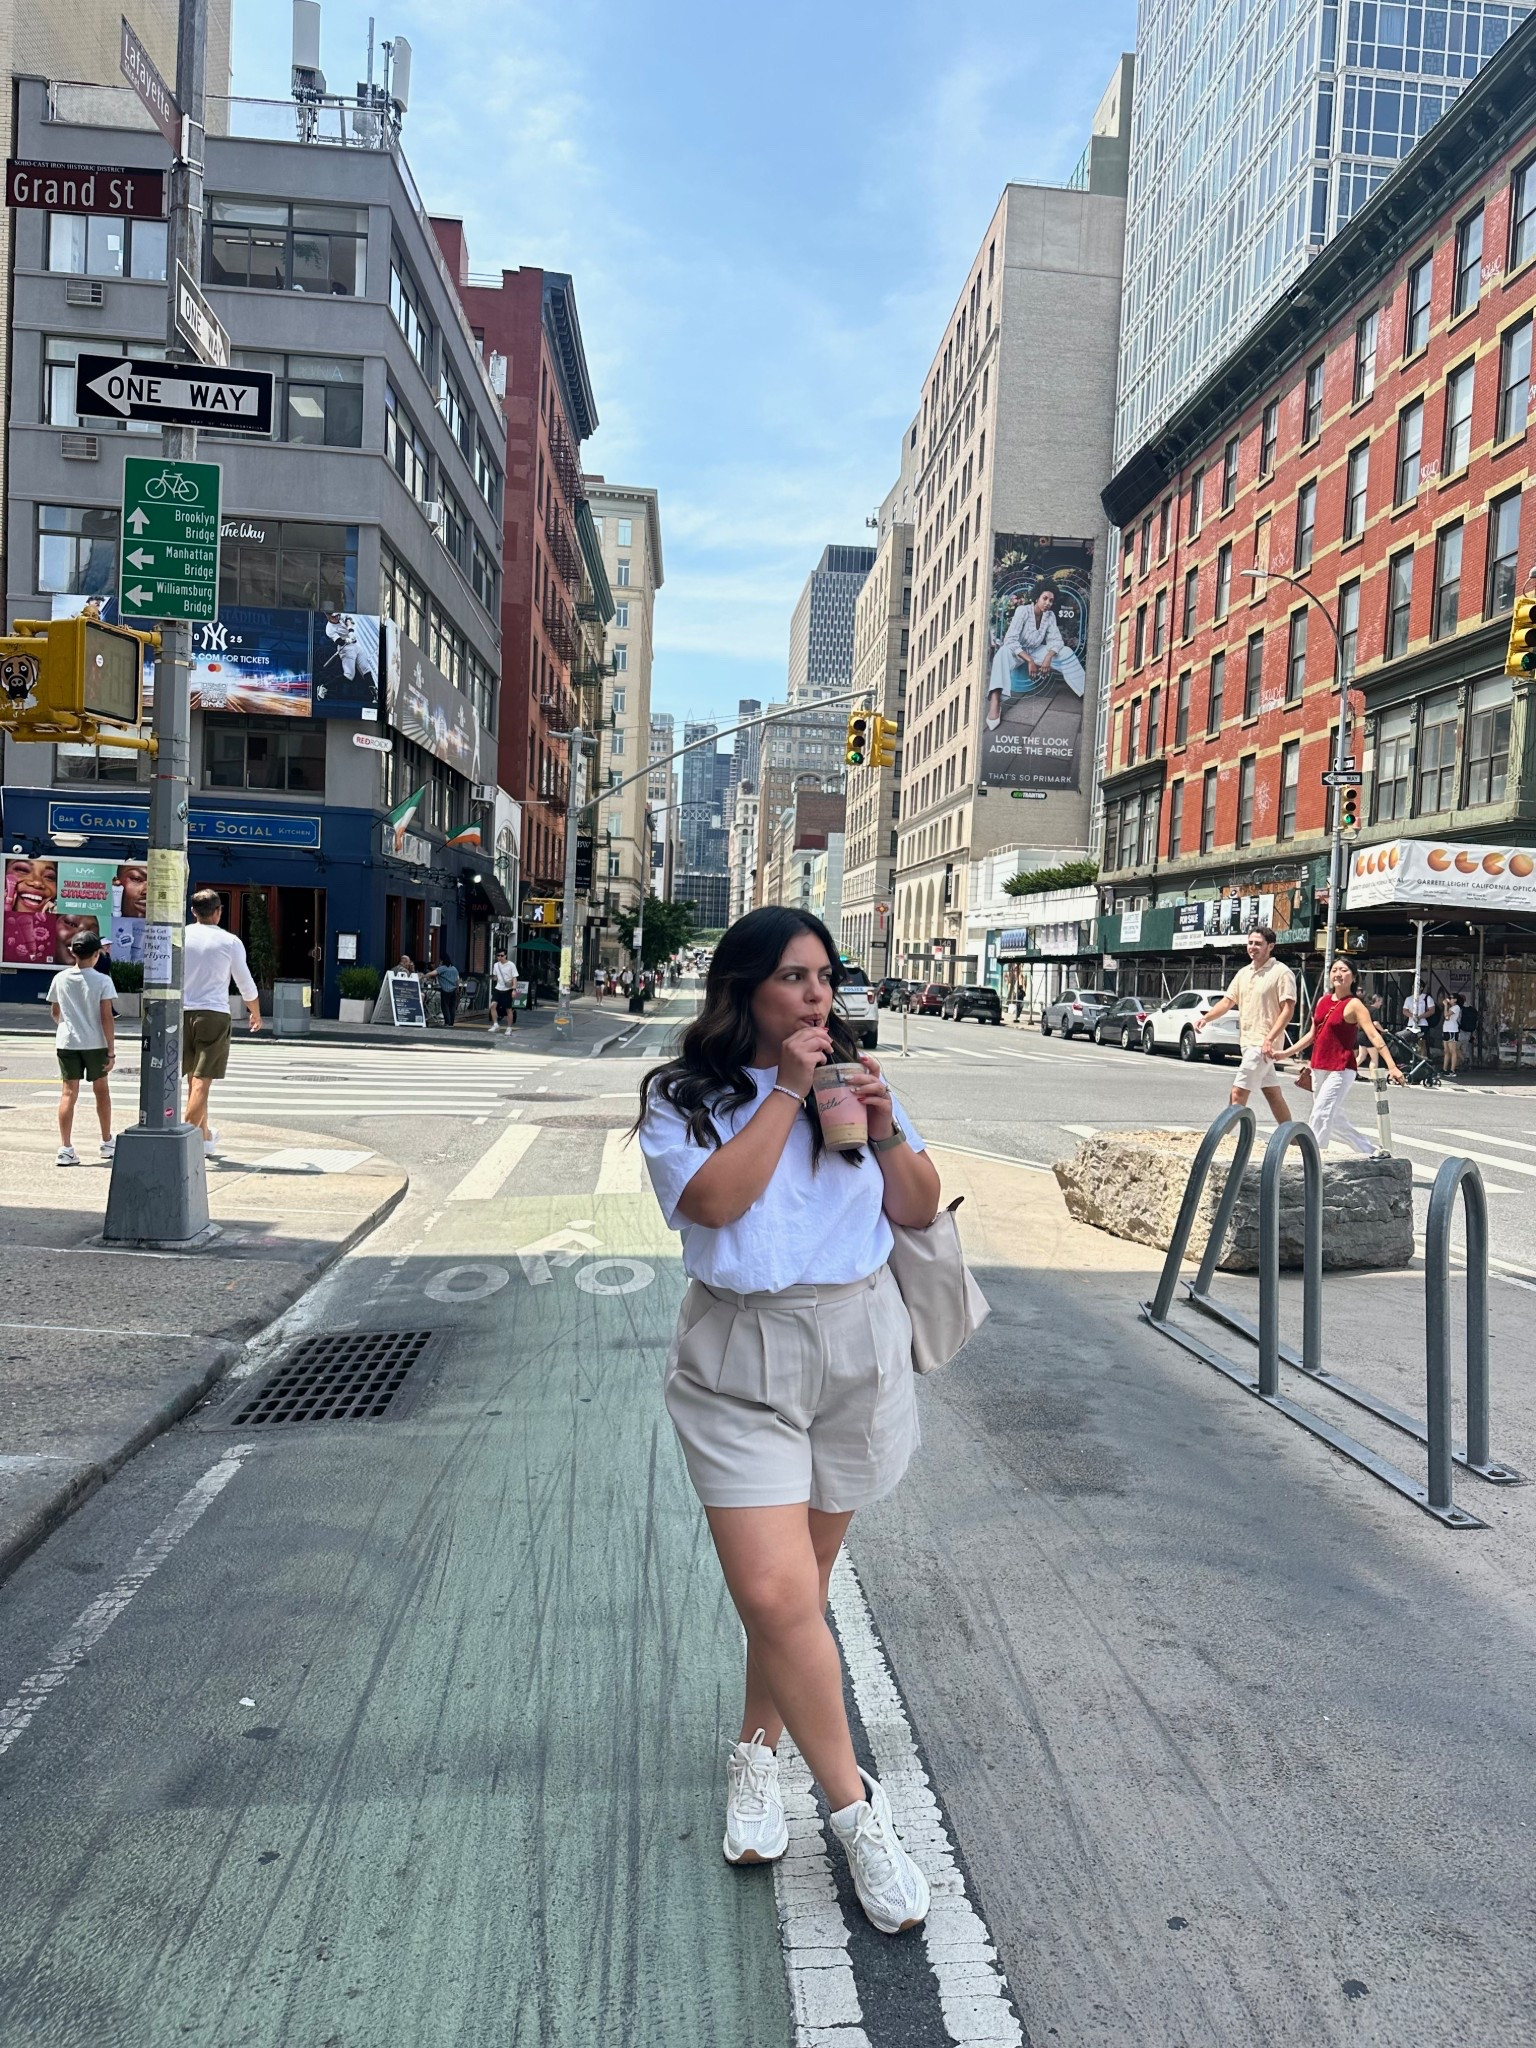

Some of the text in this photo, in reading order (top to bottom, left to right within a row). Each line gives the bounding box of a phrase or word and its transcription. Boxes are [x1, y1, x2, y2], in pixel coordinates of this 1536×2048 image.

[124, 34, 170, 123] Lafayette
[14, 160, 49, 168] SOHO-CAST
[66, 163, 97, 172] HISTORIC
[97, 165, 125, 173] DISTRICT
[13, 172, 135, 210] Grand St
[185, 296, 223, 363] ONE WAY
[107, 375, 248, 412] ONE WAY
[175, 509, 215, 526] Brooklyn
[185, 526, 215, 544] Bridge
[239, 522, 265, 544] Way
[166, 546, 214, 561] Manhattan
[184, 564, 214, 580] Bridge
[156, 581, 213, 601] Williamsburg
[183, 600, 213, 617] Bridge
[1058, 609, 1075, 619] $20
[222, 654, 239, 663] FOR
[240, 655, 270, 665] TICKETS
[995, 735, 1069, 747] LOVE THE LOOK
[989, 745, 1074, 757] ADORE THE PRICE
[988, 772, 1072, 783] THAT'S SO PRIMARK
[58, 815, 75, 823] BAR
[80, 813, 138, 829] GRAND
[215, 820, 273, 836] SOCIAL
[278, 827, 311, 836] KITCHEN
[1417, 878, 1446, 887] GARRETT
[1447, 880, 1469, 888] LEIGHT
[1471, 882, 1511, 891] CALIFORNIA
[1179, 913, 1199, 925] FOR SALE
